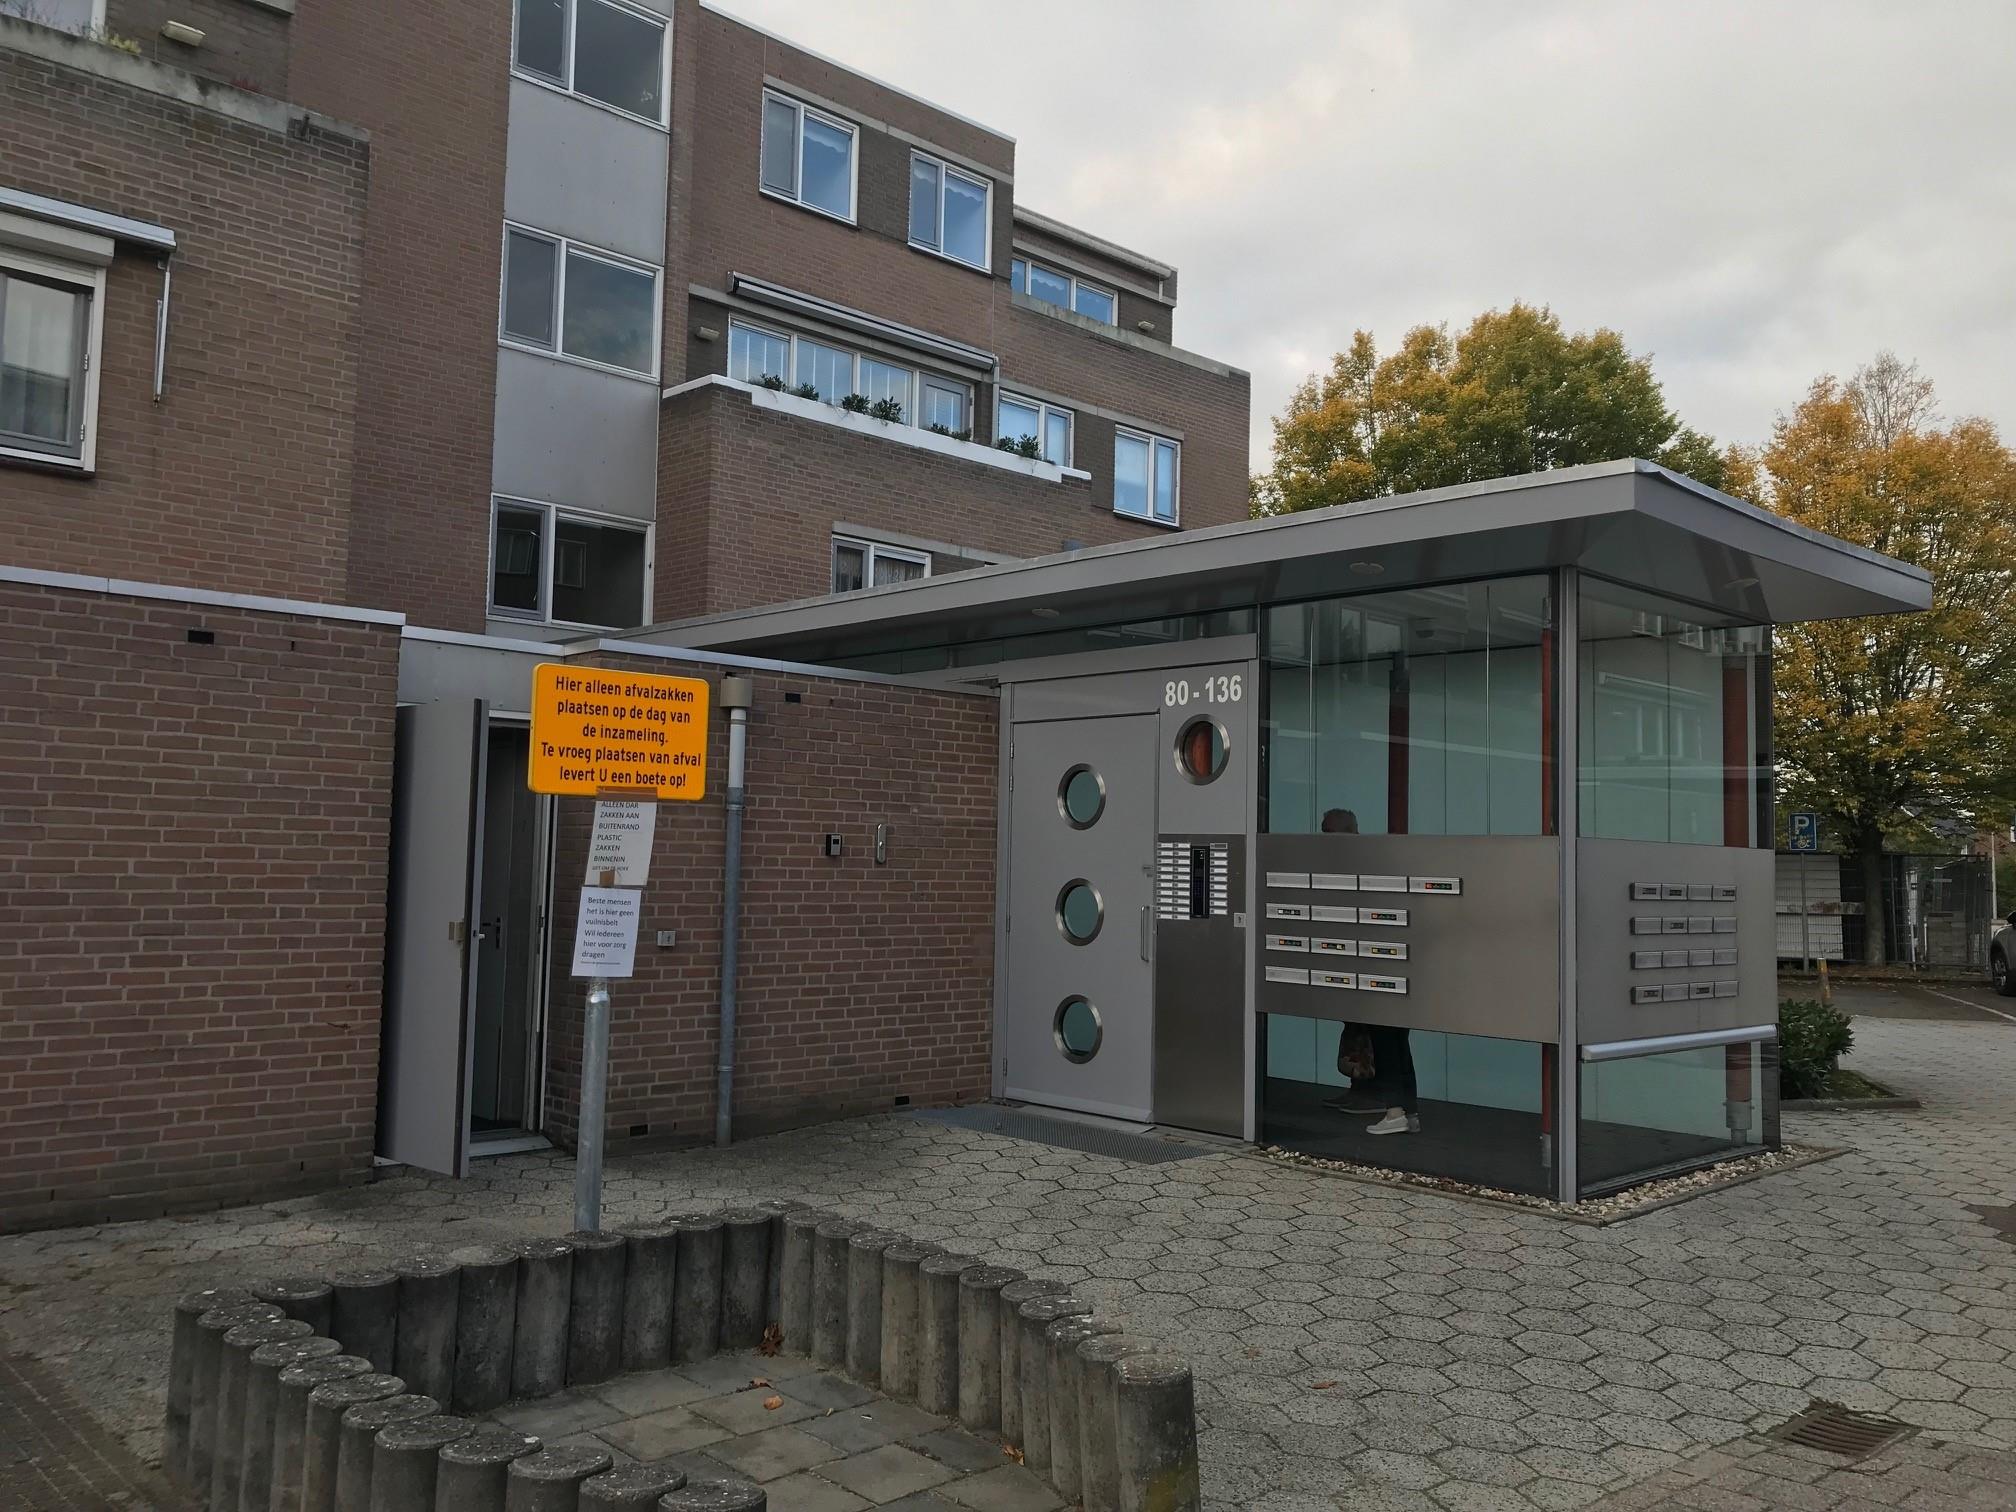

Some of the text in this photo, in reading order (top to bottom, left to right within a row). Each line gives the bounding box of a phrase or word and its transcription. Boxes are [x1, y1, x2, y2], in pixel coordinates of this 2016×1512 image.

[556, 676, 694, 702] Hier alleen afvalzakken
[1165, 680, 1189, 707] 80
[1205, 674, 1242, 703] 136
[557, 700, 690, 724] plaatsen op de dag van
[583, 723, 668, 746] de inzameling.
[541, 742, 701, 766] Te vroeg plaatsen van afval
[560, 766, 686, 788] levert U een boete op!
[1795, 816, 1810, 834] P
[606, 908, 618, 916] hier
[582, 951, 605, 959] dragen
